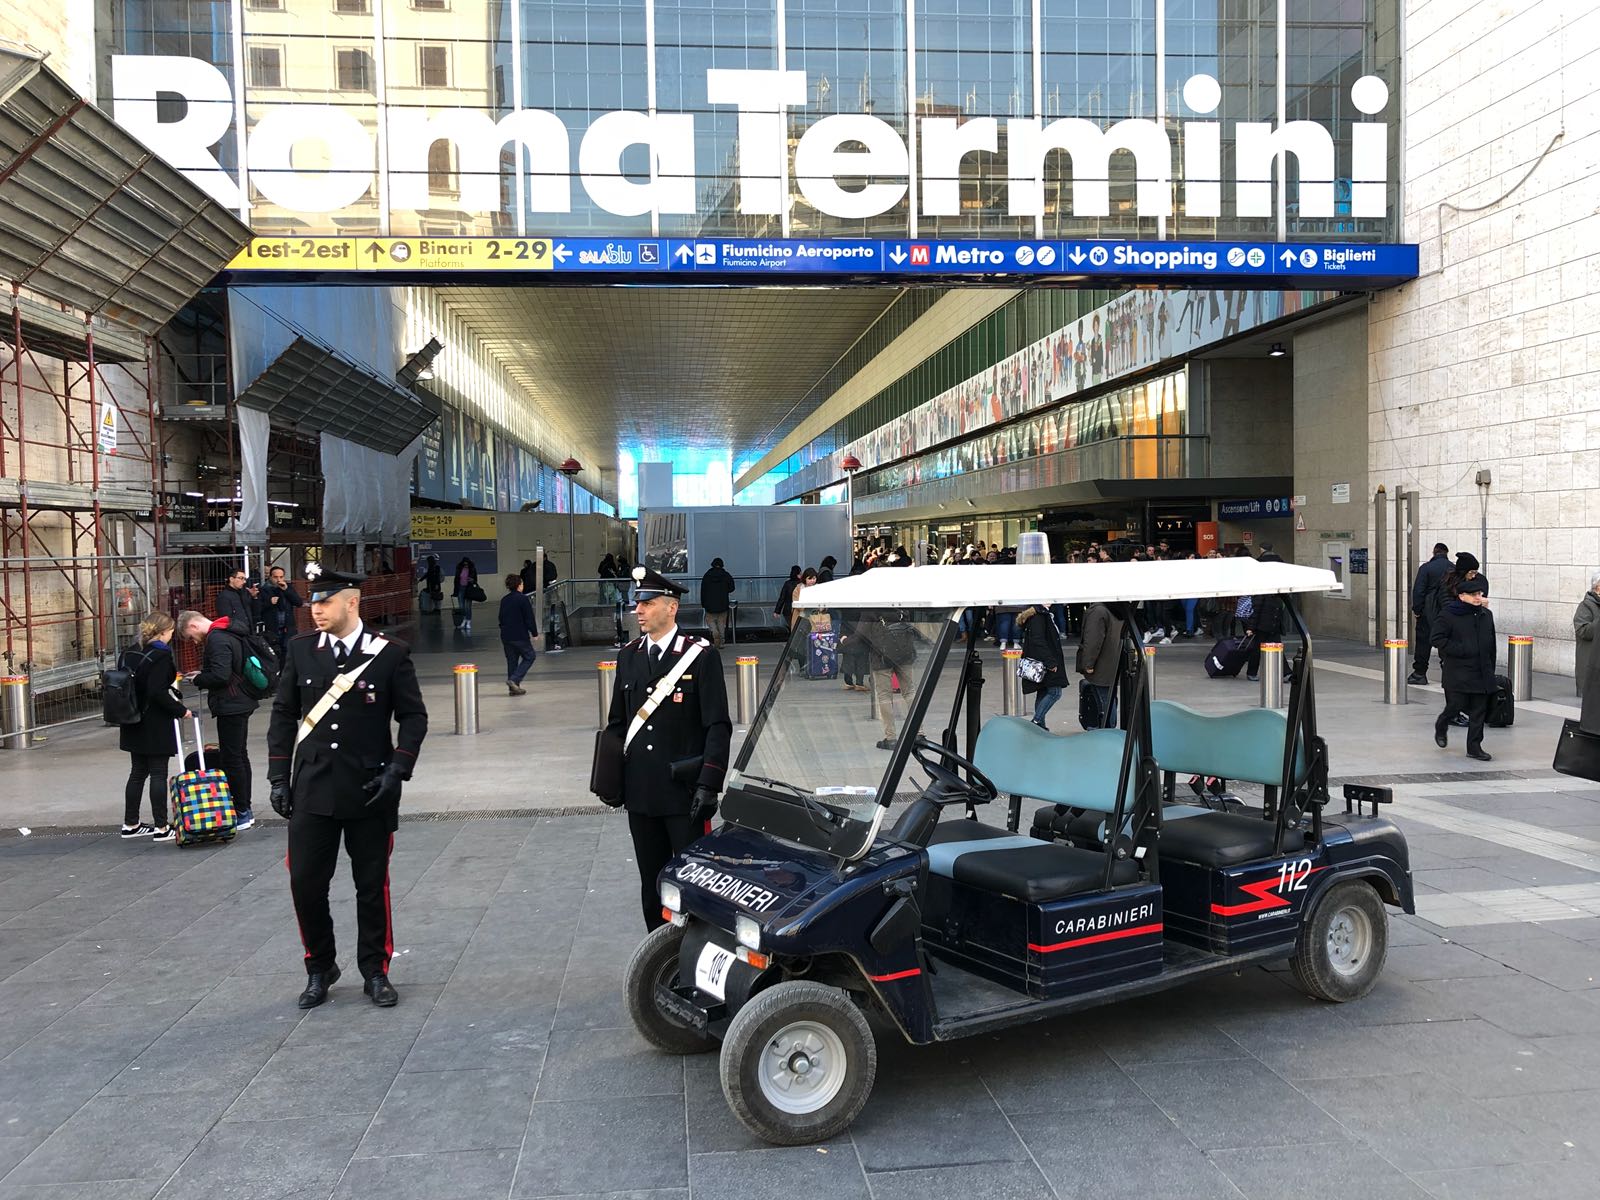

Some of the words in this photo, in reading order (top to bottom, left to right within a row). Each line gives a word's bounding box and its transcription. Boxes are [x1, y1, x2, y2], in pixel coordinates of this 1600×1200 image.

[111, 55, 696, 217] Roma
[706, 68, 1388, 219] Termini
[419, 241, 472, 256] Binari
[486, 240, 547, 260] 2-29
[722, 243, 793, 257] Fiumicino
[797, 244, 874, 261] Aeroporto
[912, 251, 928, 263] M
[935, 246, 1005, 264] Metro
[1113, 246, 1218, 270] Shopping
[1323, 249, 1376, 263] Biglietti
[419, 257, 464, 269] Platforms
[723, 258, 757, 267] Fiumicino
[759, 258, 787, 268] Airport
[1324, 262, 1346, 271] Tickets
[436, 516, 453, 525] 2-29
[1277, 858, 1312, 894] 112
[677, 862, 780, 913] CARABINIERI
[1055, 903, 1153, 934] CARABINIERI
[707, 951, 729, 986] 109
